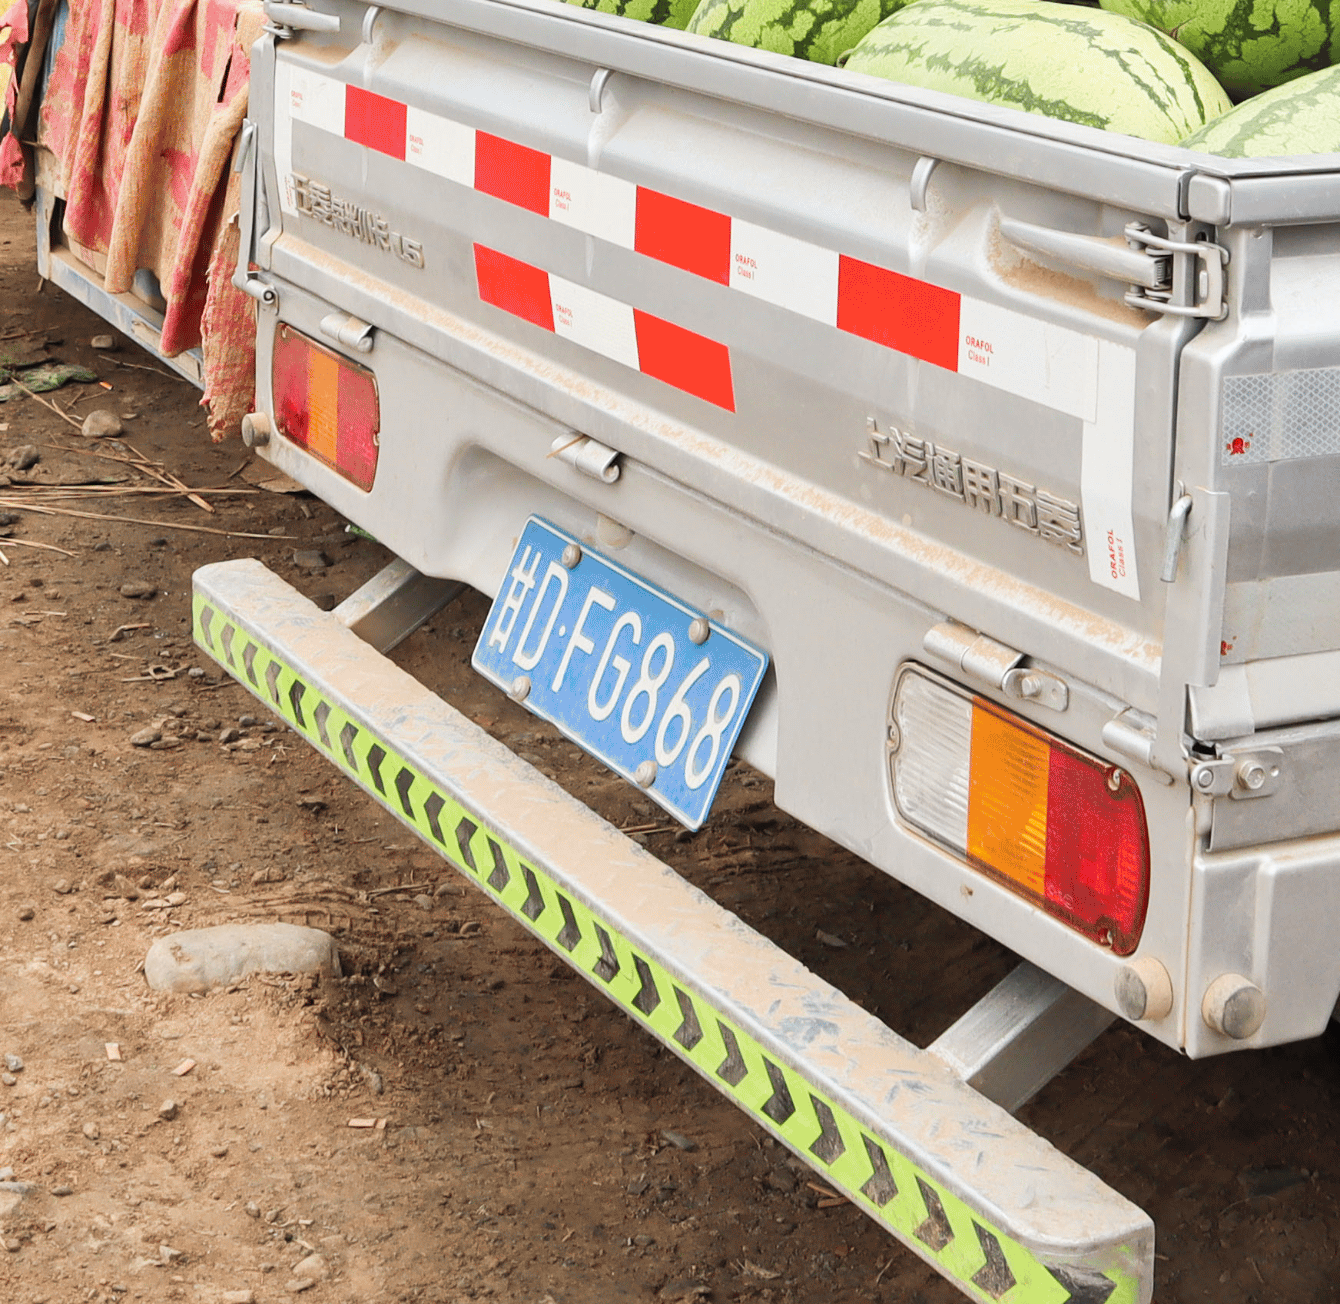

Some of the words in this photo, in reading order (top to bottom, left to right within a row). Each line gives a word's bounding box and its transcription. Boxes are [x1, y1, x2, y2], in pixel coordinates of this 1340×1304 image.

[965, 335, 994, 354] ORAFOL
[968, 349, 986, 365] Class
[858, 416, 1084, 557] 上汽通用五菱
[1107, 528, 1118, 579] ORAFOL
